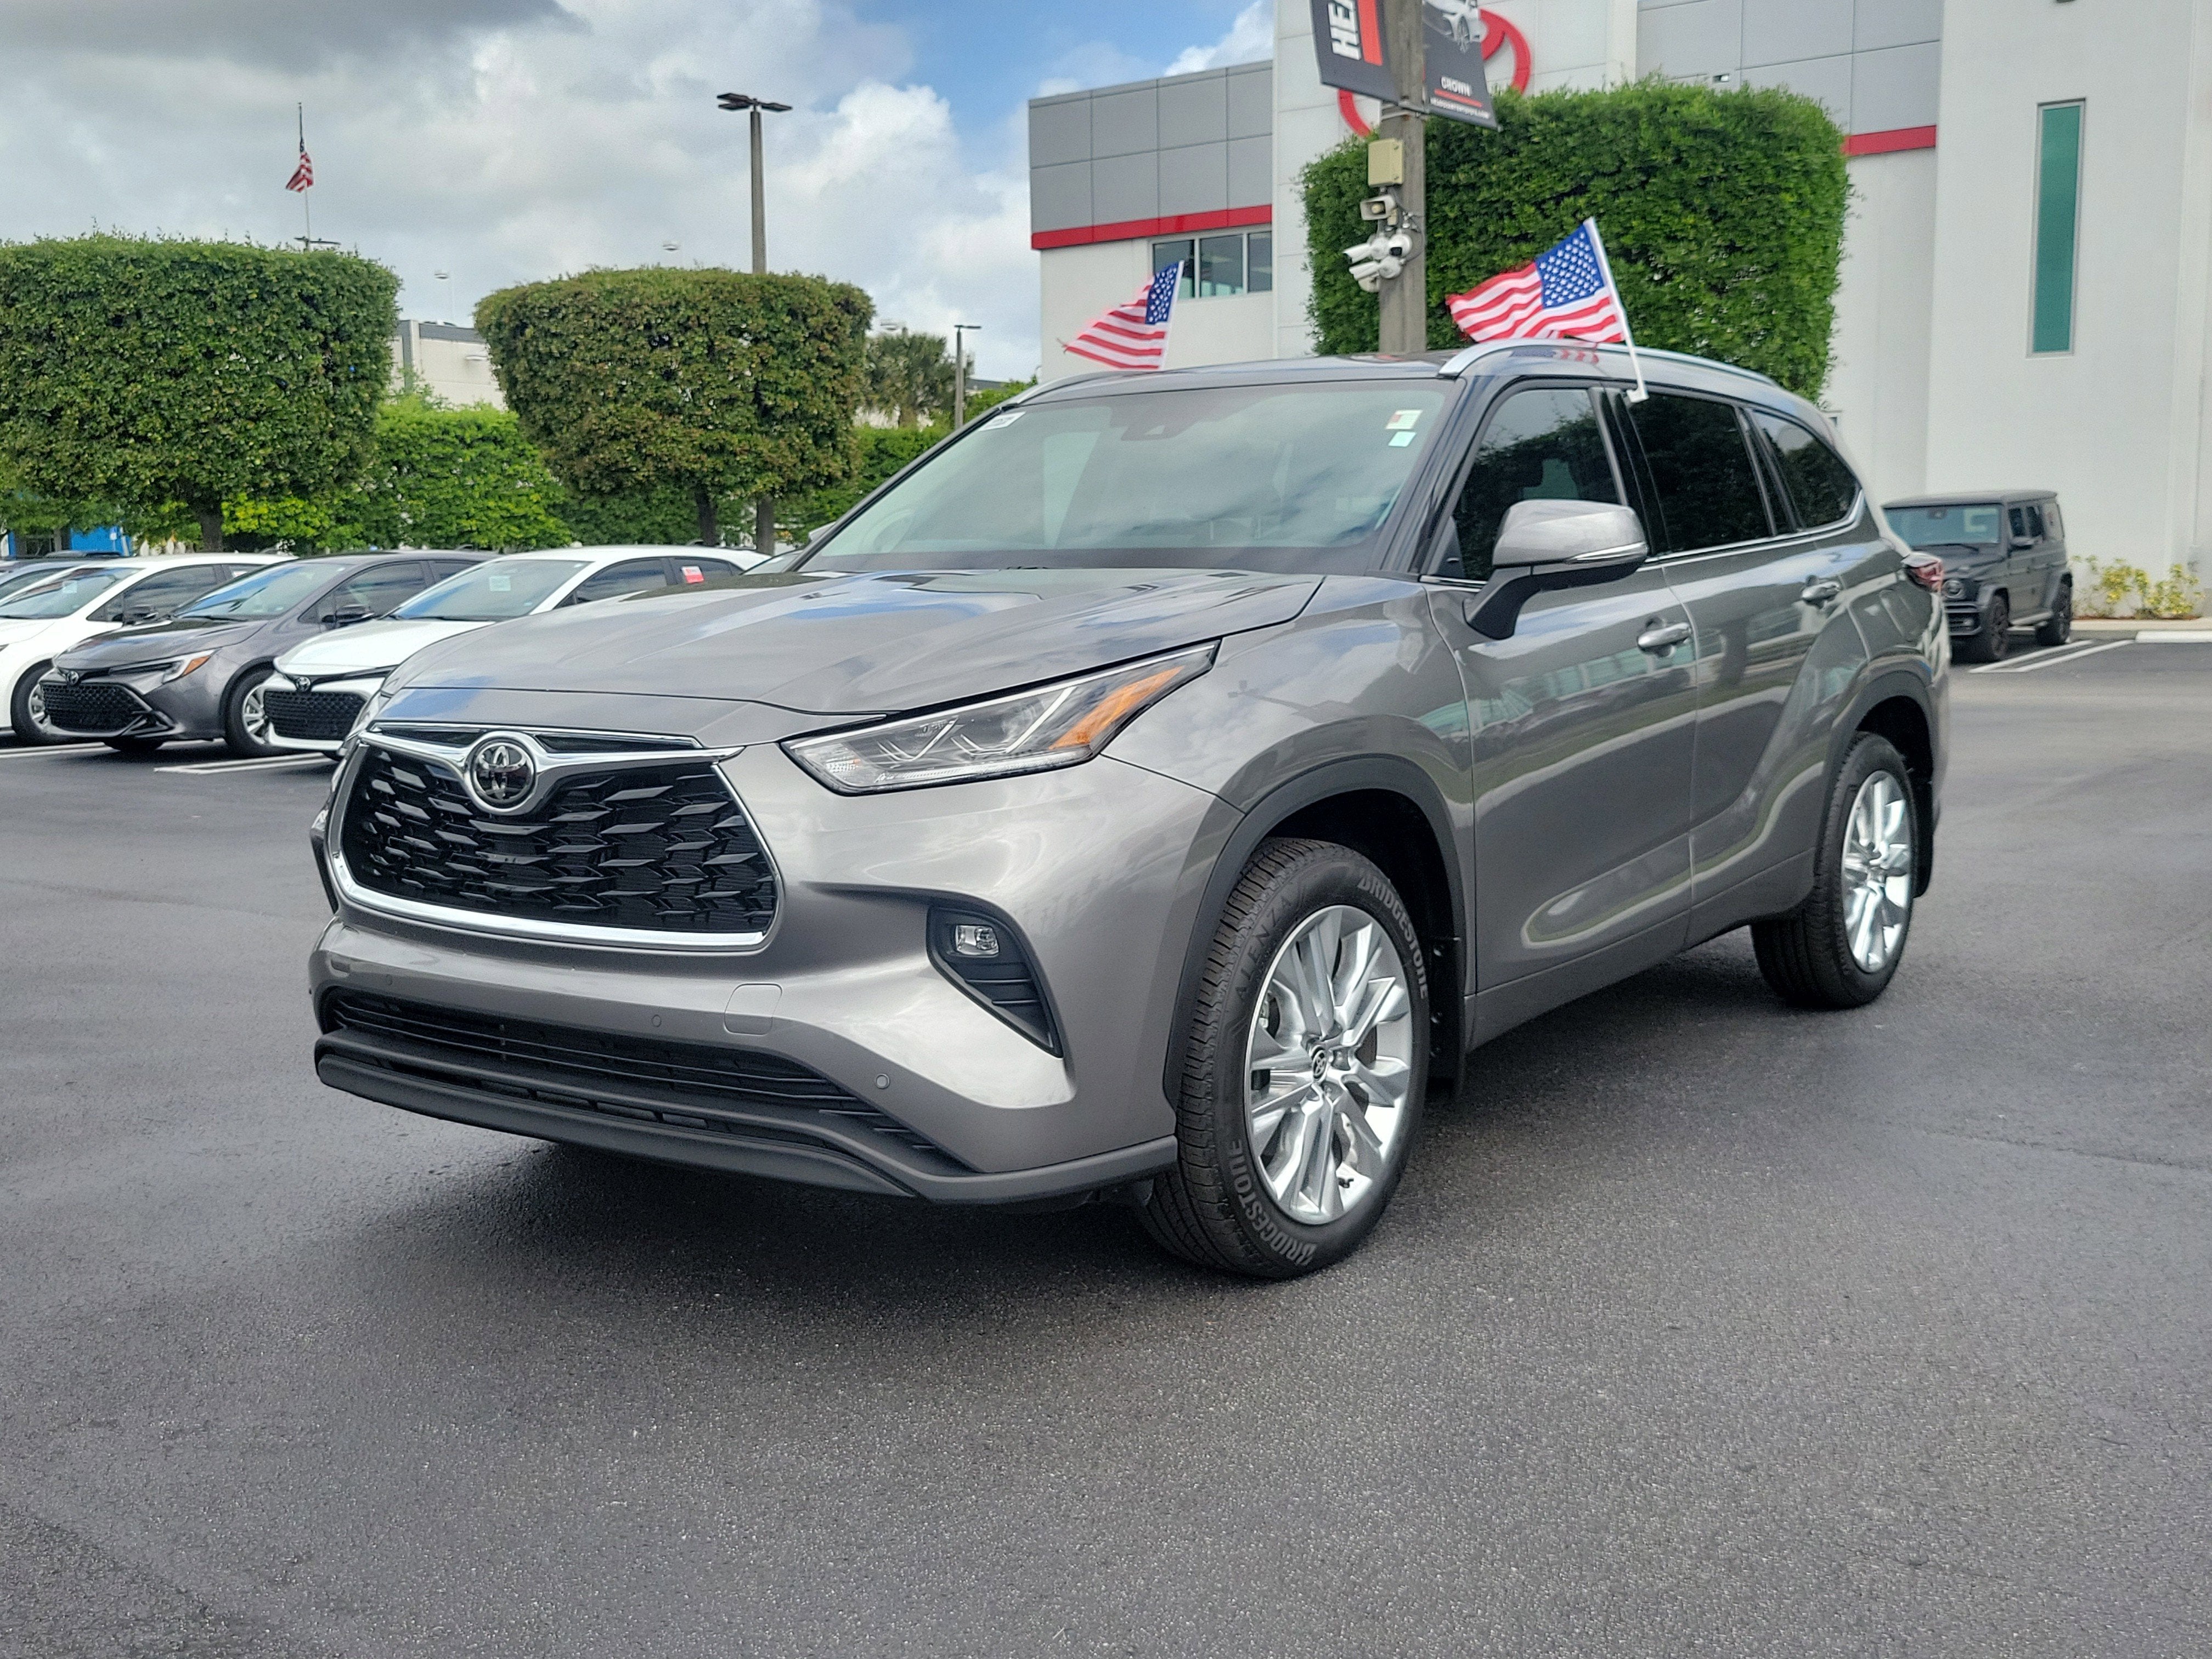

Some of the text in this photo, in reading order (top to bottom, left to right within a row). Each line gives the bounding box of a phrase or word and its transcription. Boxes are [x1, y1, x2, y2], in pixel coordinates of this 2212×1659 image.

[1328, 0, 1361, 61] HE
[1358, 875, 1427, 1000] BRIDGESTONE
[1231, 1138, 1317, 1266] BRIDGESTONE
